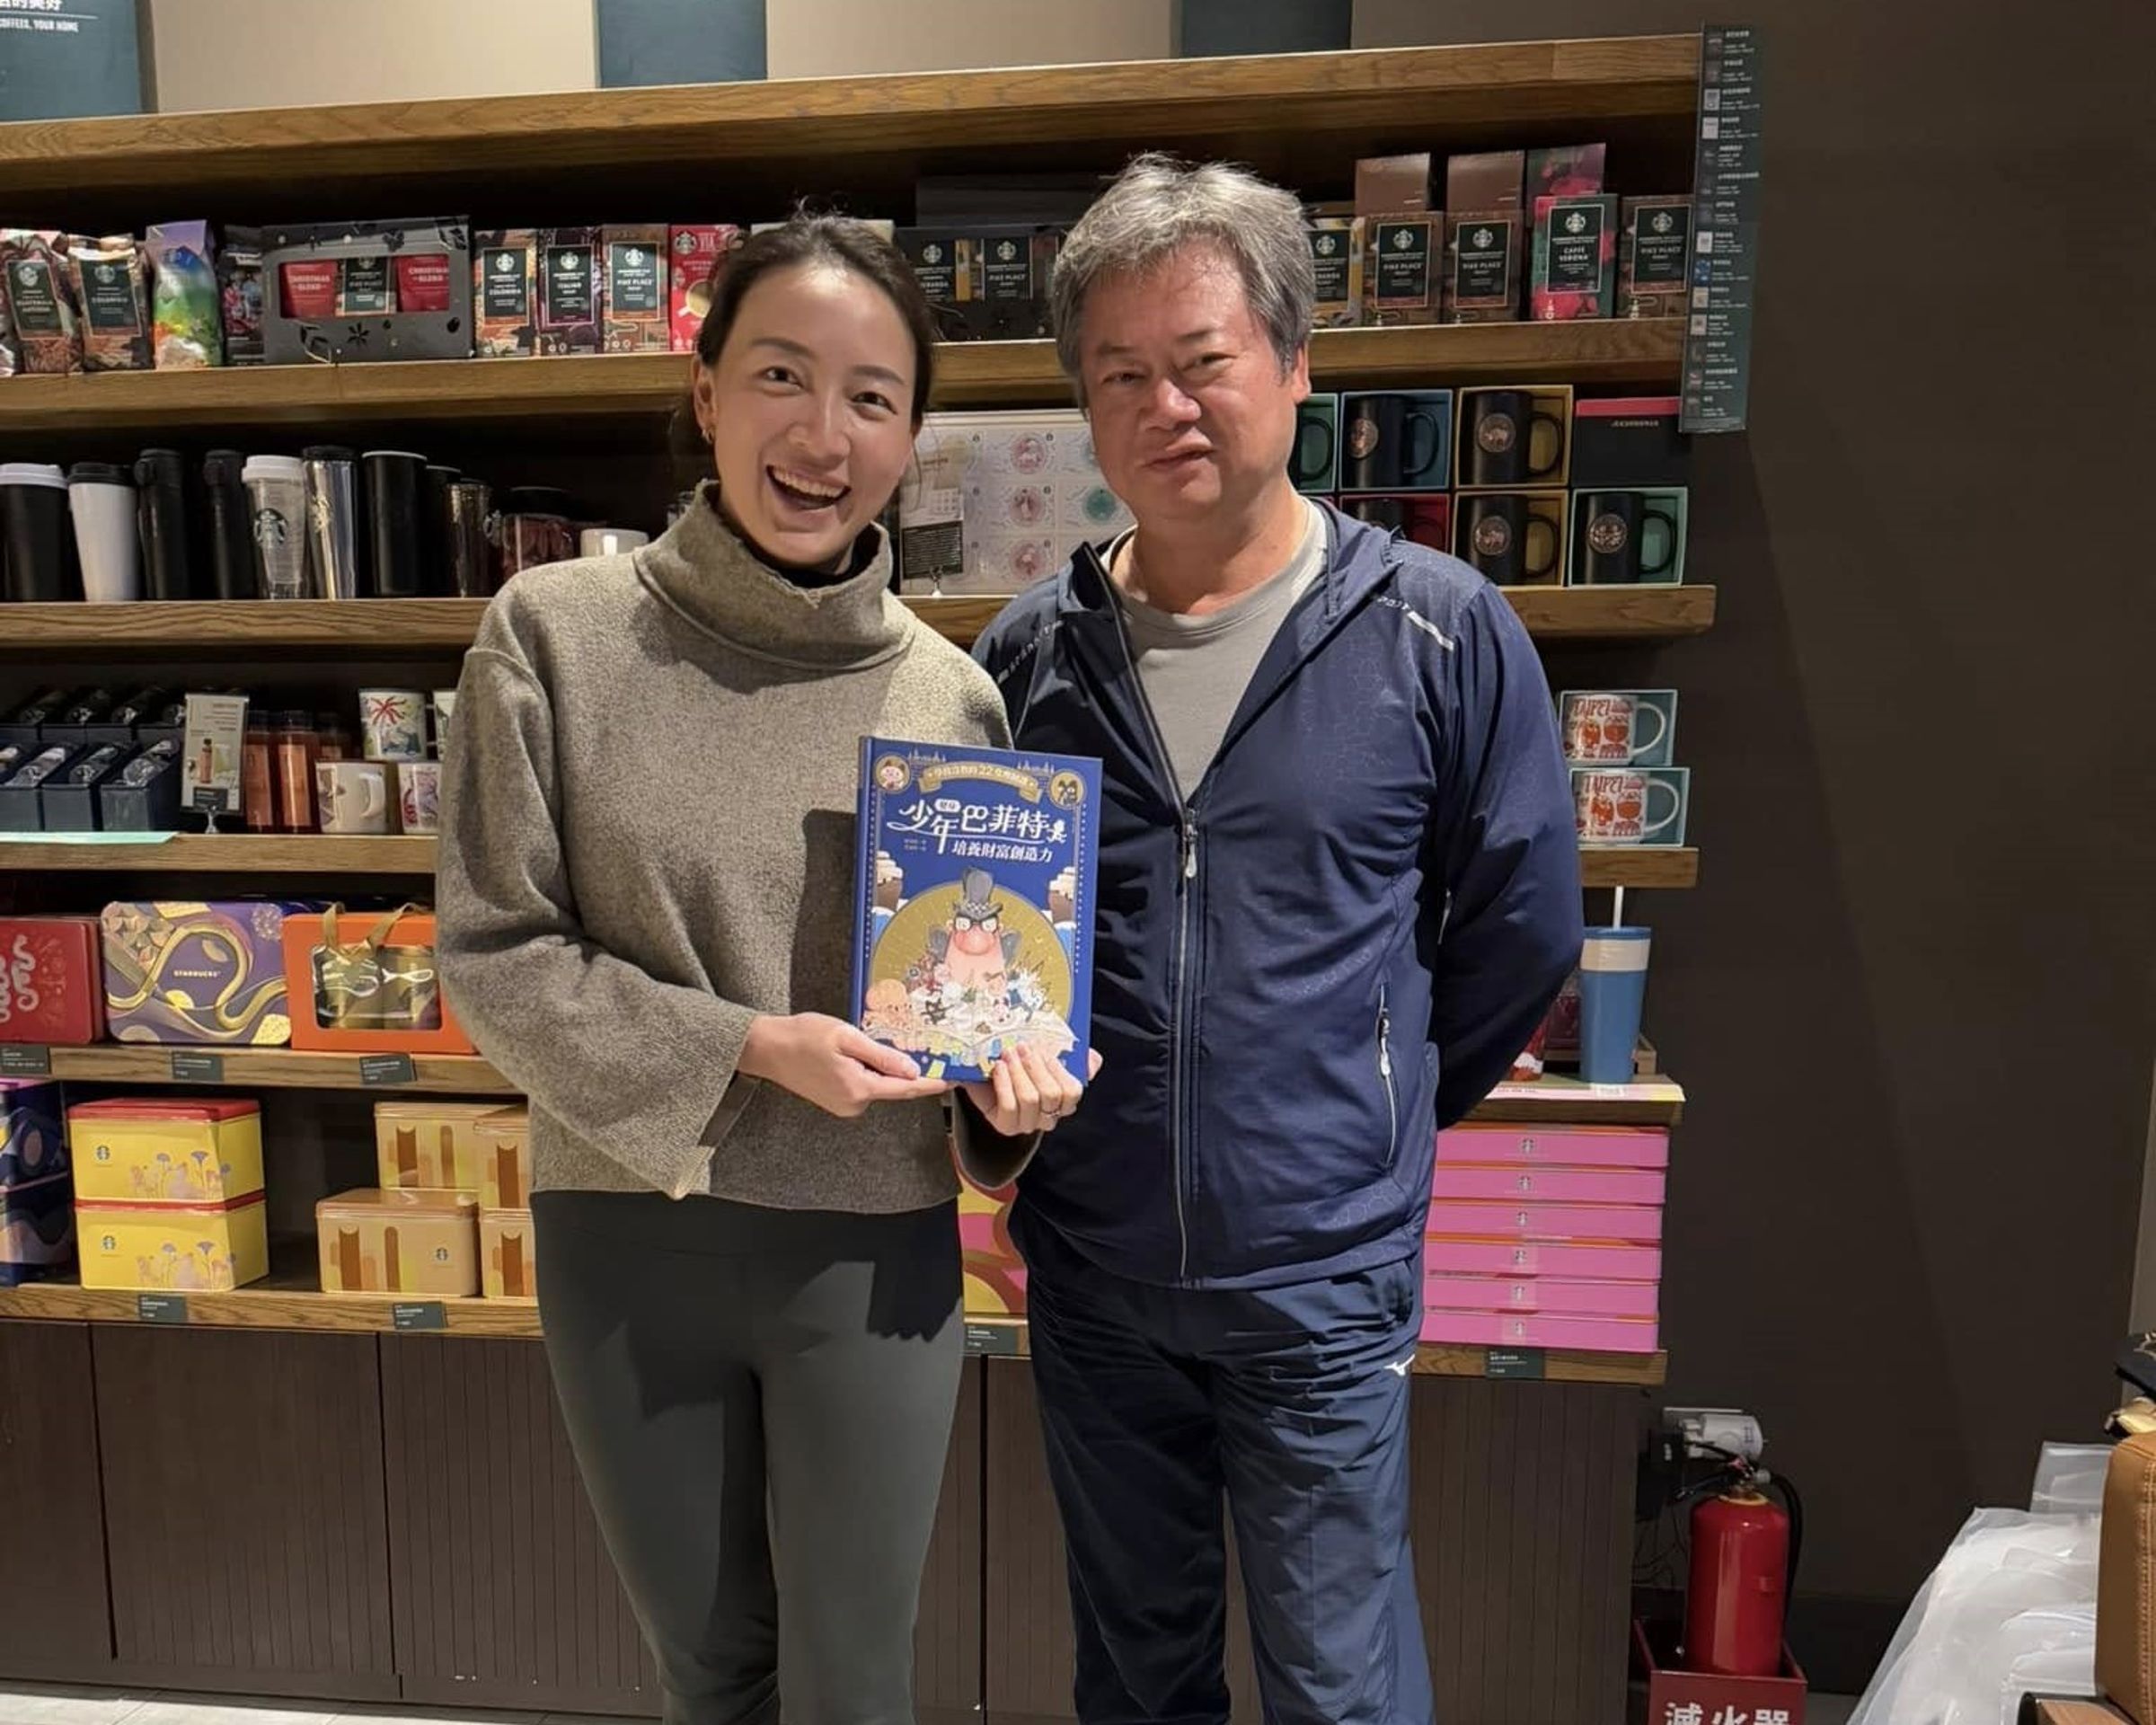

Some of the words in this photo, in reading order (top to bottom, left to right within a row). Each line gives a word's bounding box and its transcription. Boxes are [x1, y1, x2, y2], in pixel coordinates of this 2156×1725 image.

[889, 799, 1050, 854] 少年巴菲特
[951, 840, 1054, 863] 培養財富創造力
